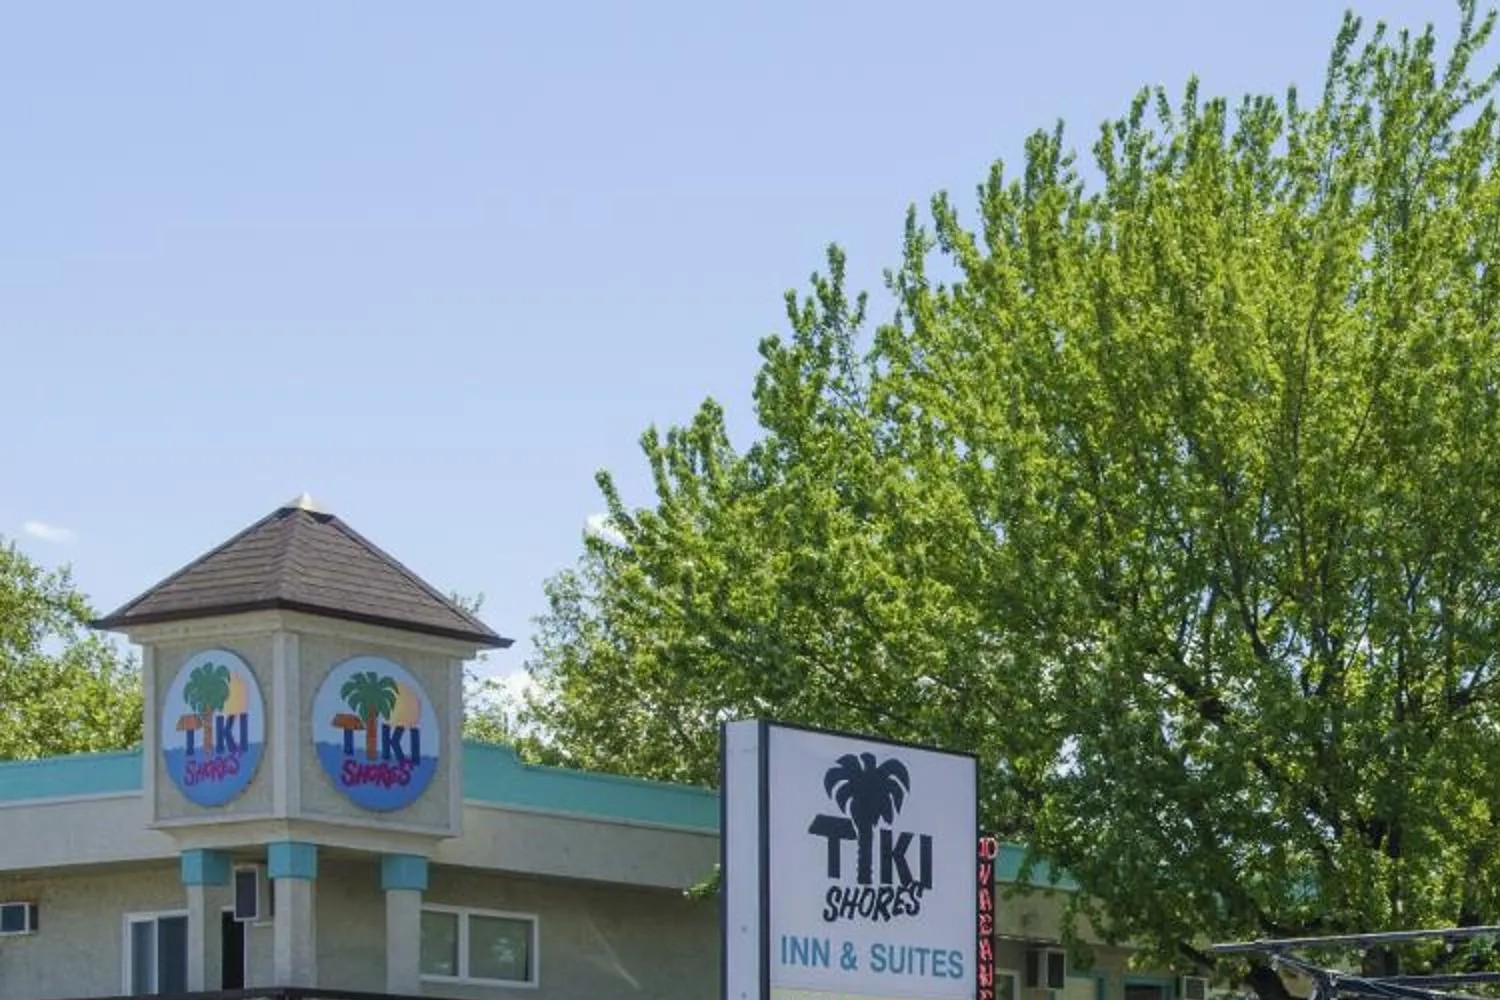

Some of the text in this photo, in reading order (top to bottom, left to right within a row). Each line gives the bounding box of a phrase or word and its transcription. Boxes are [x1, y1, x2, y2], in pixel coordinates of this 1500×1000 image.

[175, 702, 249, 756] TIKI
[331, 707, 421, 766] TIKI
[341, 757, 411, 788] SHORES
[807, 812, 933, 890] TIKI
[823, 883, 923, 922] SHORES
[781, 935, 964, 980] INN & SUITES
